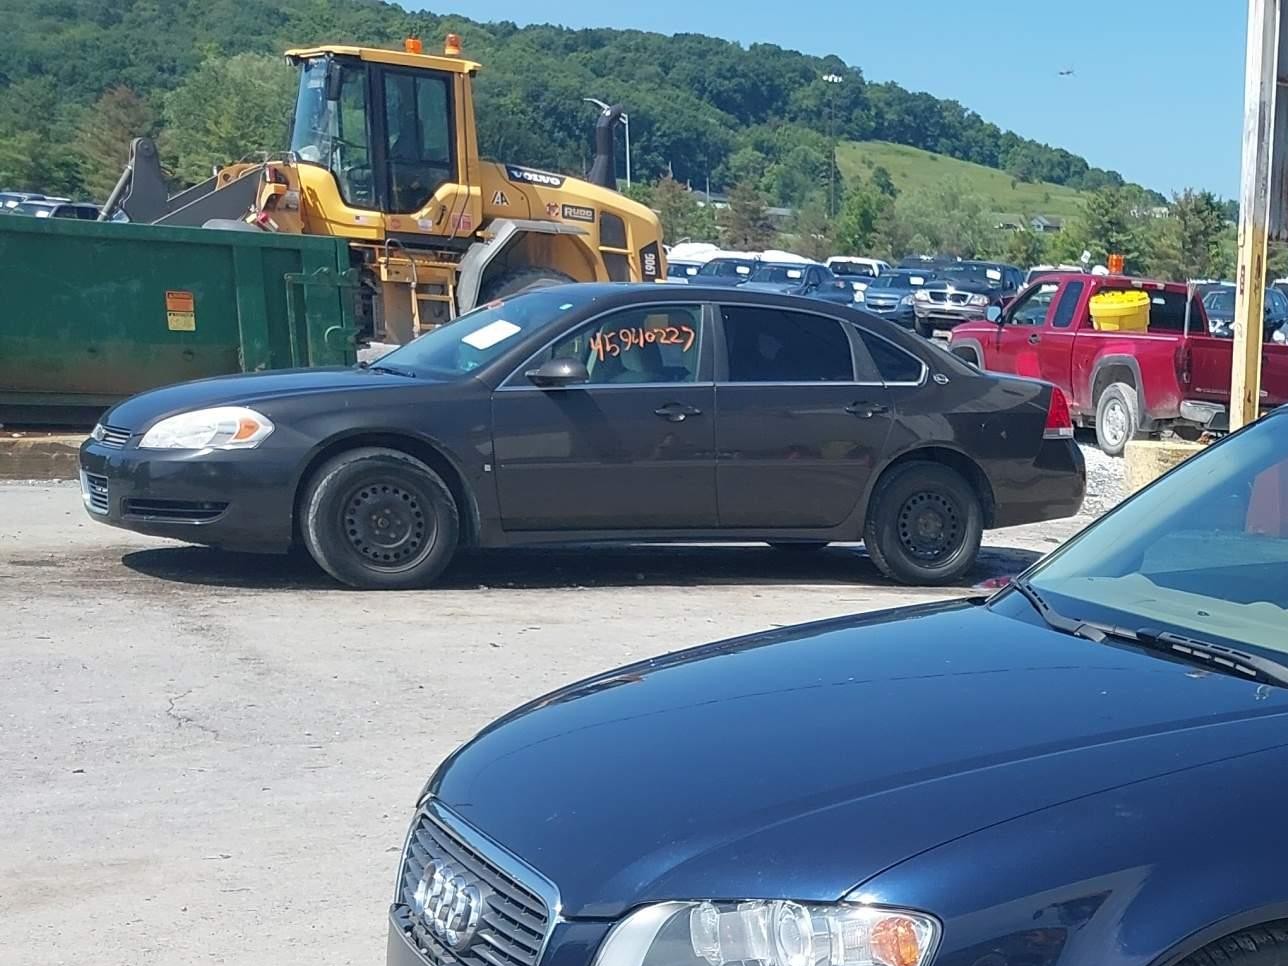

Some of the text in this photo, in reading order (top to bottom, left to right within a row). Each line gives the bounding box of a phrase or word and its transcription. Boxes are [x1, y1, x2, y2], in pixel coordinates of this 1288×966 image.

[511, 170, 561, 186] VOLVO
[564, 206, 593, 218] RUDD
[645, 253, 656, 276] L90G
